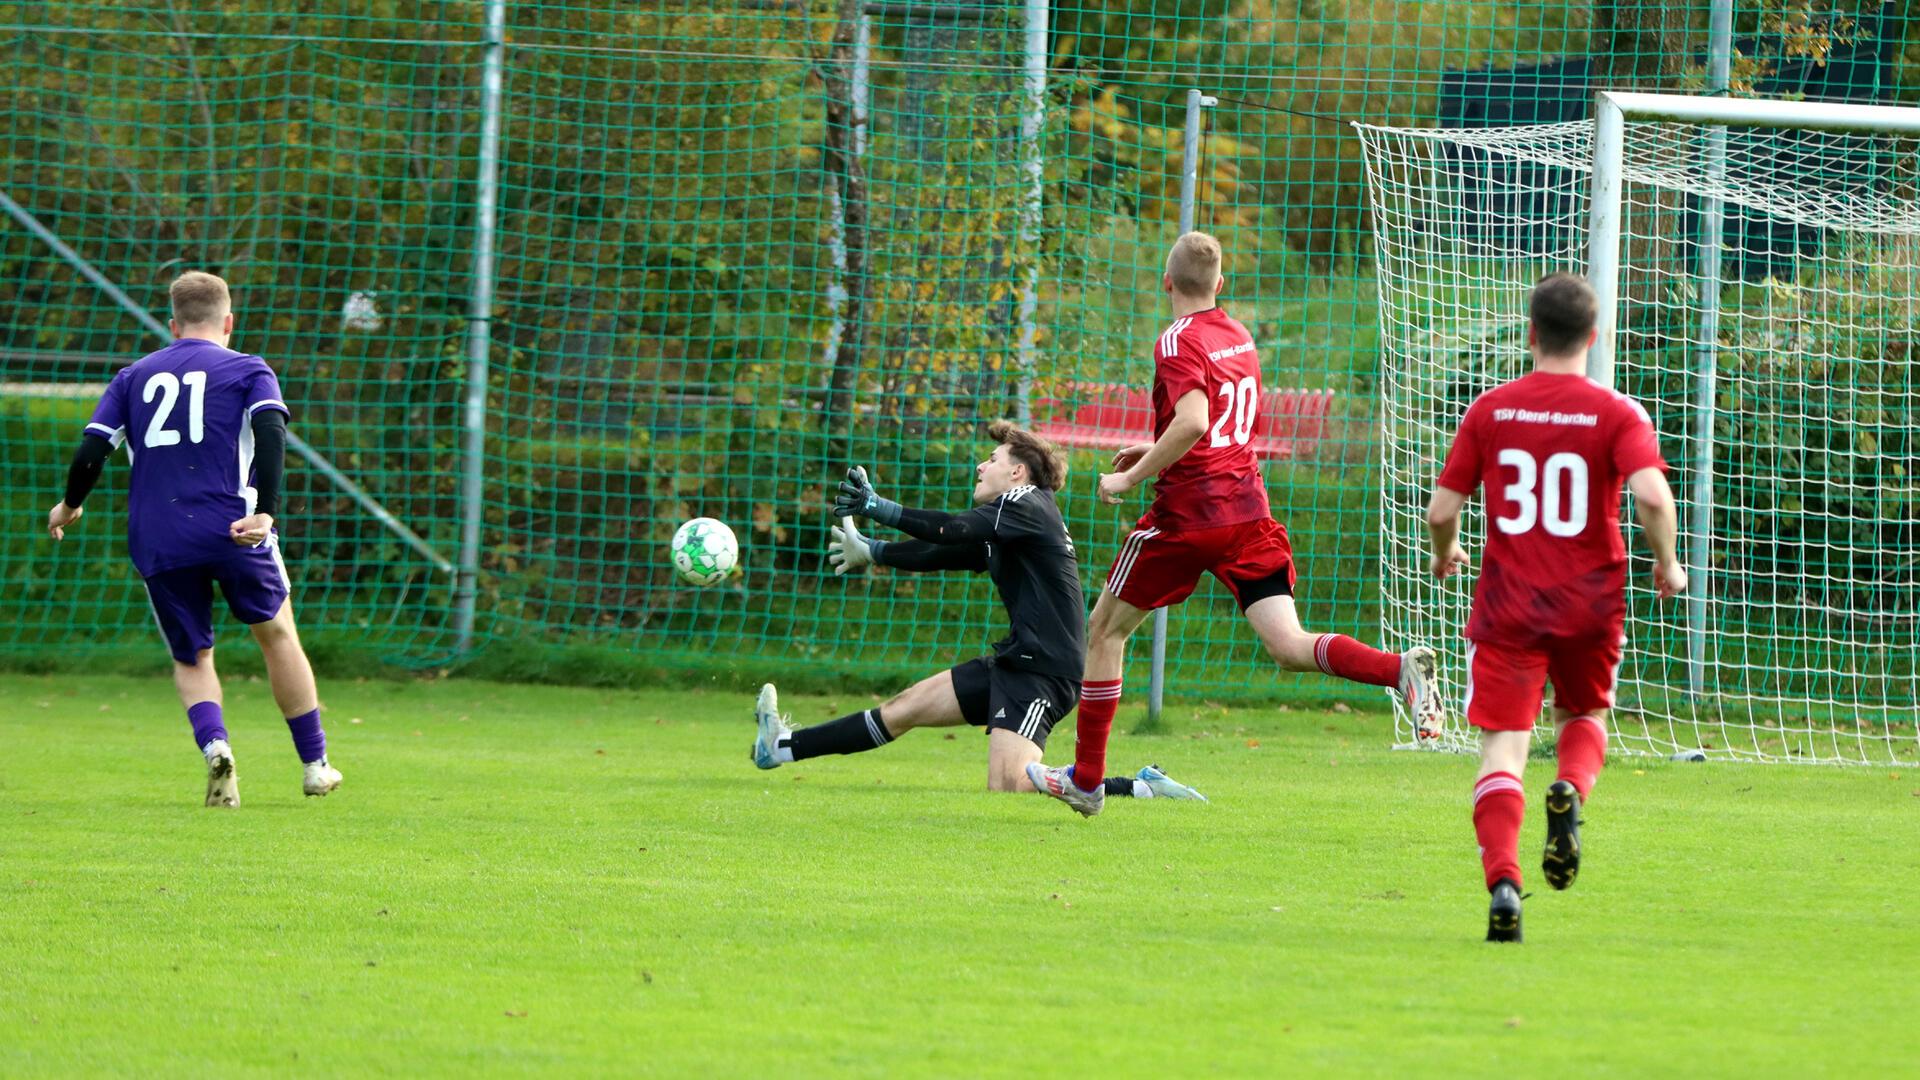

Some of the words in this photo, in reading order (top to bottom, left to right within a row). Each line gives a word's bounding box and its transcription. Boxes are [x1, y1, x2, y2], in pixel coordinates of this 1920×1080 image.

[142, 371, 206, 448] 21
[1210, 376, 1257, 448] 20
[1493, 408, 1516, 422] TSV
[1496, 448, 1589, 537] 30
